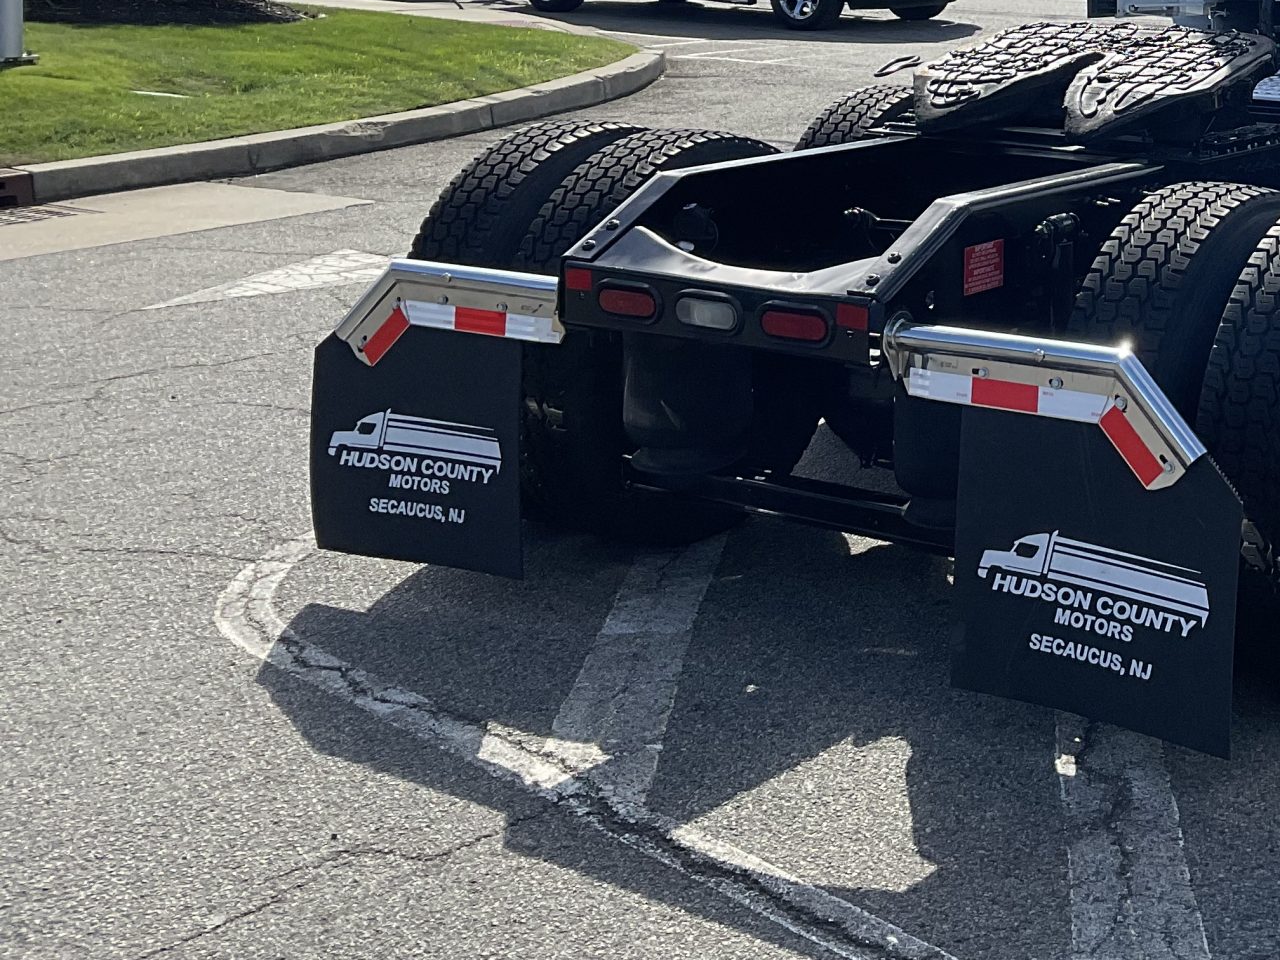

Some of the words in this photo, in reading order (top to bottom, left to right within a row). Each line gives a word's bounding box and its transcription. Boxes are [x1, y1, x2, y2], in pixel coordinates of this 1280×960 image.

[340, 450, 418, 472] HUDSON
[421, 460, 494, 484] COUNTY
[388, 474, 450, 494] MOTORS
[369, 497, 446, 523] SECAUCUS,
[448, 508, 465, 523] NJ
[992, 573, 1093, 610] HUDSON
[1096, 596, 1197, 637] COUNTY
[1054, 607, 1134, 642] MOTORS
[1029, 633, 1125, 675] SECAUCUS,
[1129, 659, 1153, 680] NJ
